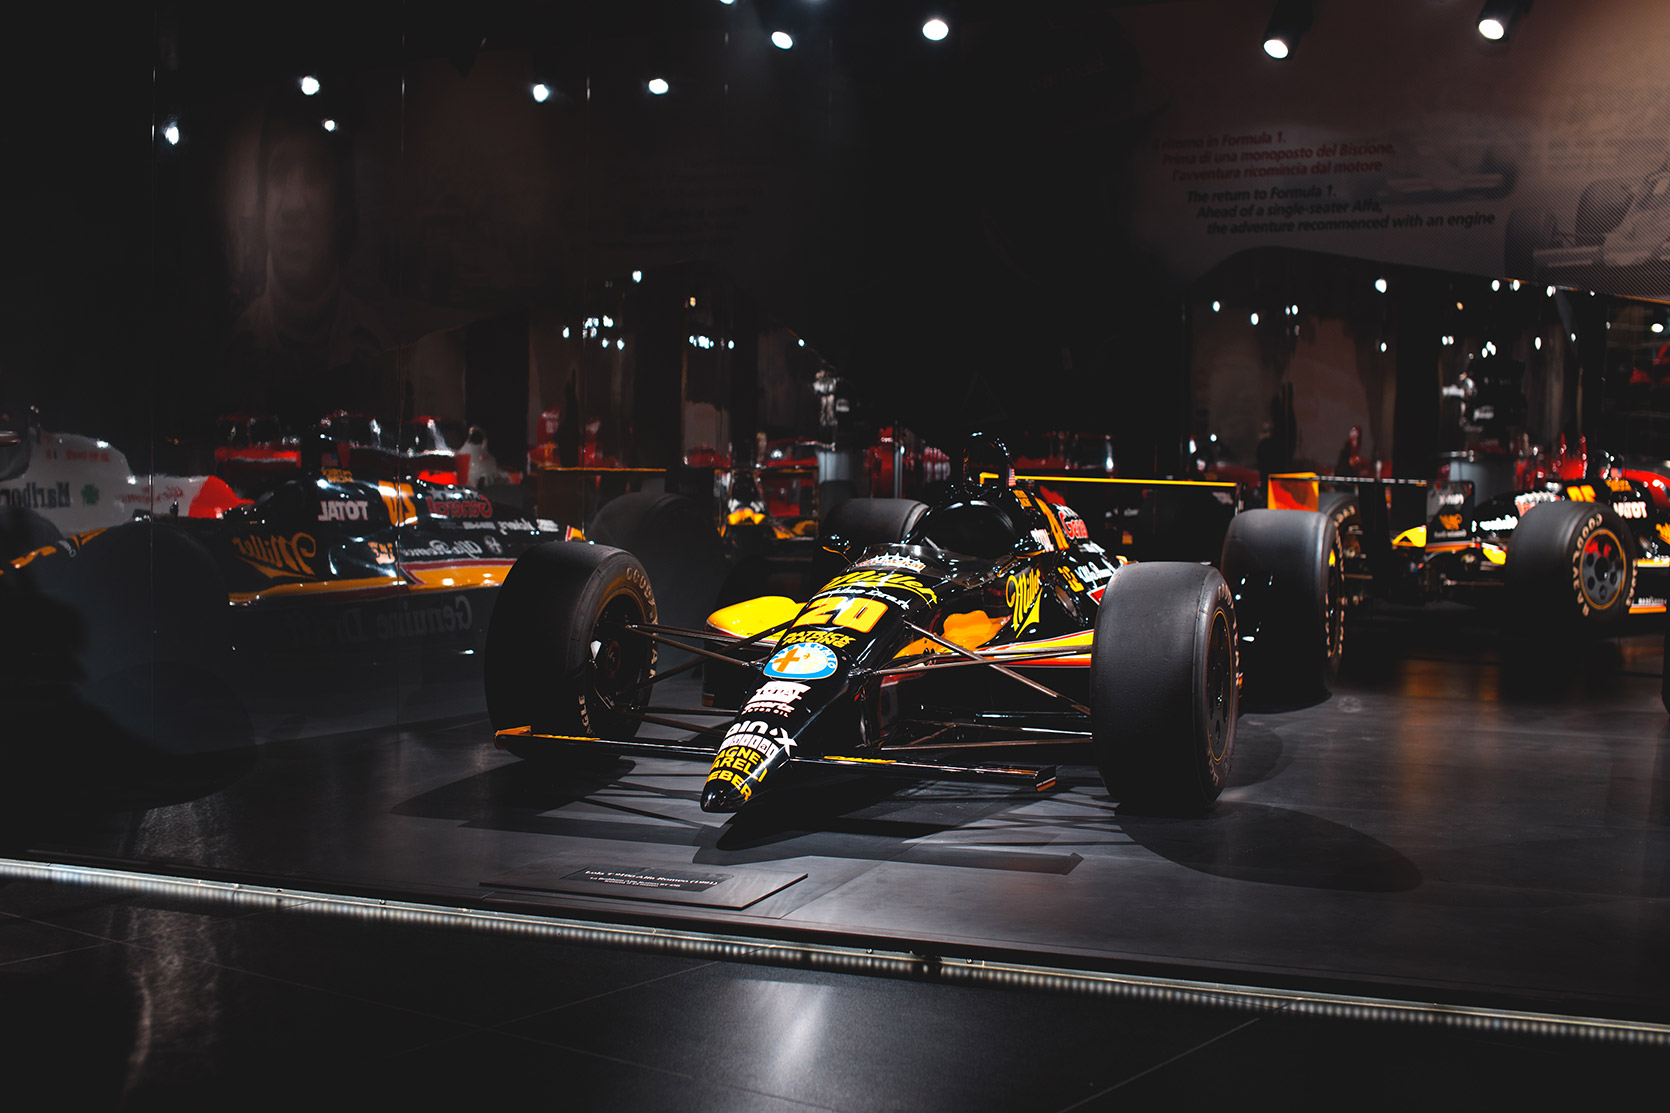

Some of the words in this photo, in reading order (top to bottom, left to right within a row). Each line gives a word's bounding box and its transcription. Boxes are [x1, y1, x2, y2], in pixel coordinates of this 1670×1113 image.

[1206, 134, 1219, 147] in
[1221, 131, 1274, 146] Formula
[1276, 131, 1287, 144] 1.
[1162, 152, 1196, 166] Prima
[1199, 150, 1212, 164] di
[1214, 151, 1238, 164] una
[1240, 147, 1314, 165] monoposto
[1316, 143, 1337, 158] del
[1340, 141, 1397, 157] Biscione,
[1172, 165, 1242, 182] l'avventura
[1243, 162, 1308, 178] ricomincia
[1310, 160, 1332, 176] dal
[1333, 159, 1384, 174] motore
[1187, 190, 1210, 203] The
[1212, 188, 1251, 202] return
[1253, 188, 1267, 200] to
[1270, 185, 1323, 200] Formula
[1326, 184, 1337, 197] 1.
[1196, 205, 1238, 219] Ahead
[1239, 203, 1255, 217] of
[1266, 200, 1349, 219] single-seater
[1351, 199, 1384, 214] Alfa,
[1207, 221, 1229, 235] the
[1231, 218, 1296, 234] adventure
[1297, 216, 1390, 232] recommenced
[1392, 214, 1424, 228] with
[1426, 215, 1444, 226] an
[1447, 212, 1496, 230] engine
[790, 596, 889, 634] 20
